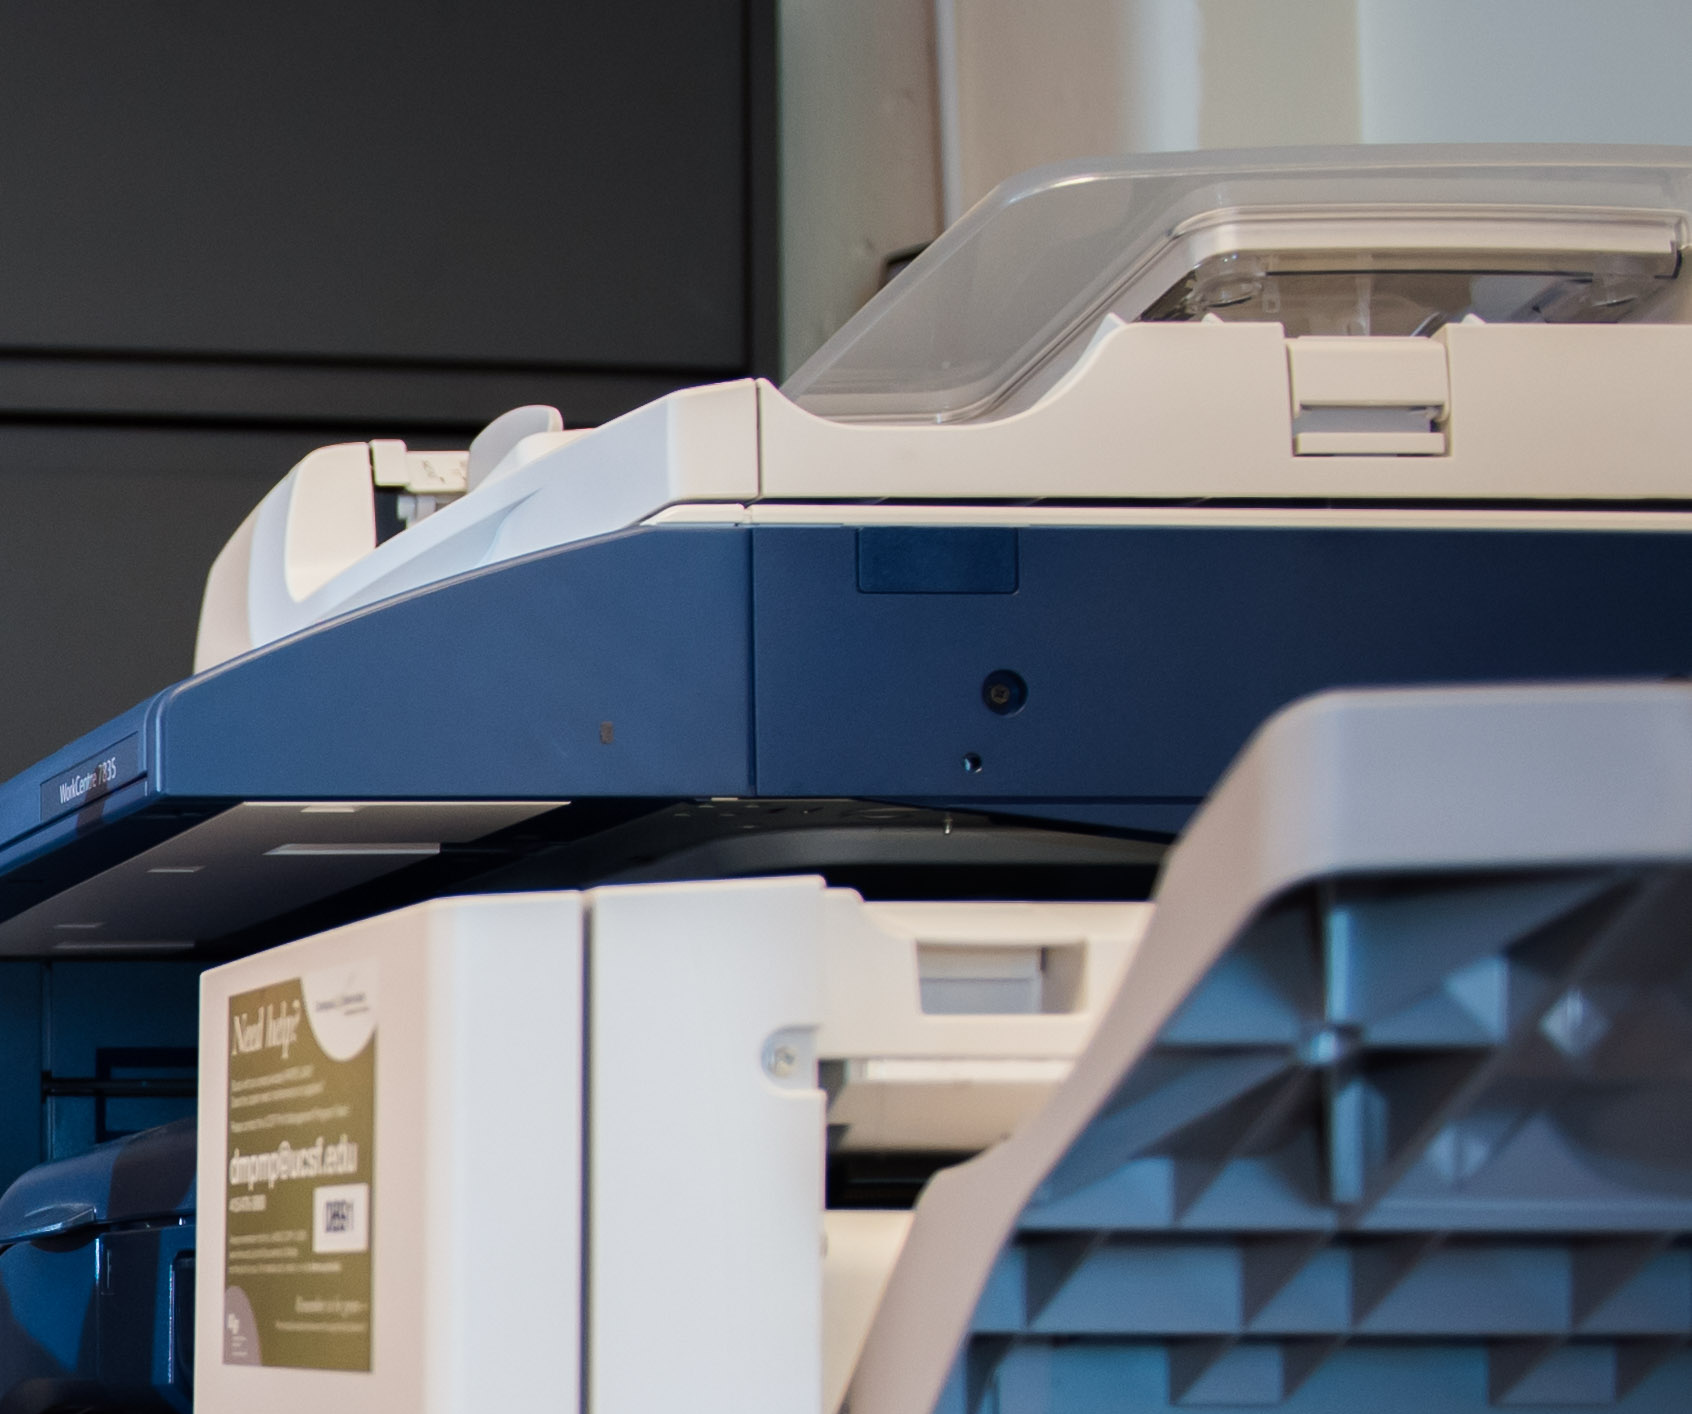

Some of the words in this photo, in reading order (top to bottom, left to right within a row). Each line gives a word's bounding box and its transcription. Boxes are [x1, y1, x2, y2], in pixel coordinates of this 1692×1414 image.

[59, 772, 97, 804] WorkCentre
[97, 756, 117, 785] 7835
[231, 1006, 265, 1056] Need
[265, 1000, 301, 1059] help?
